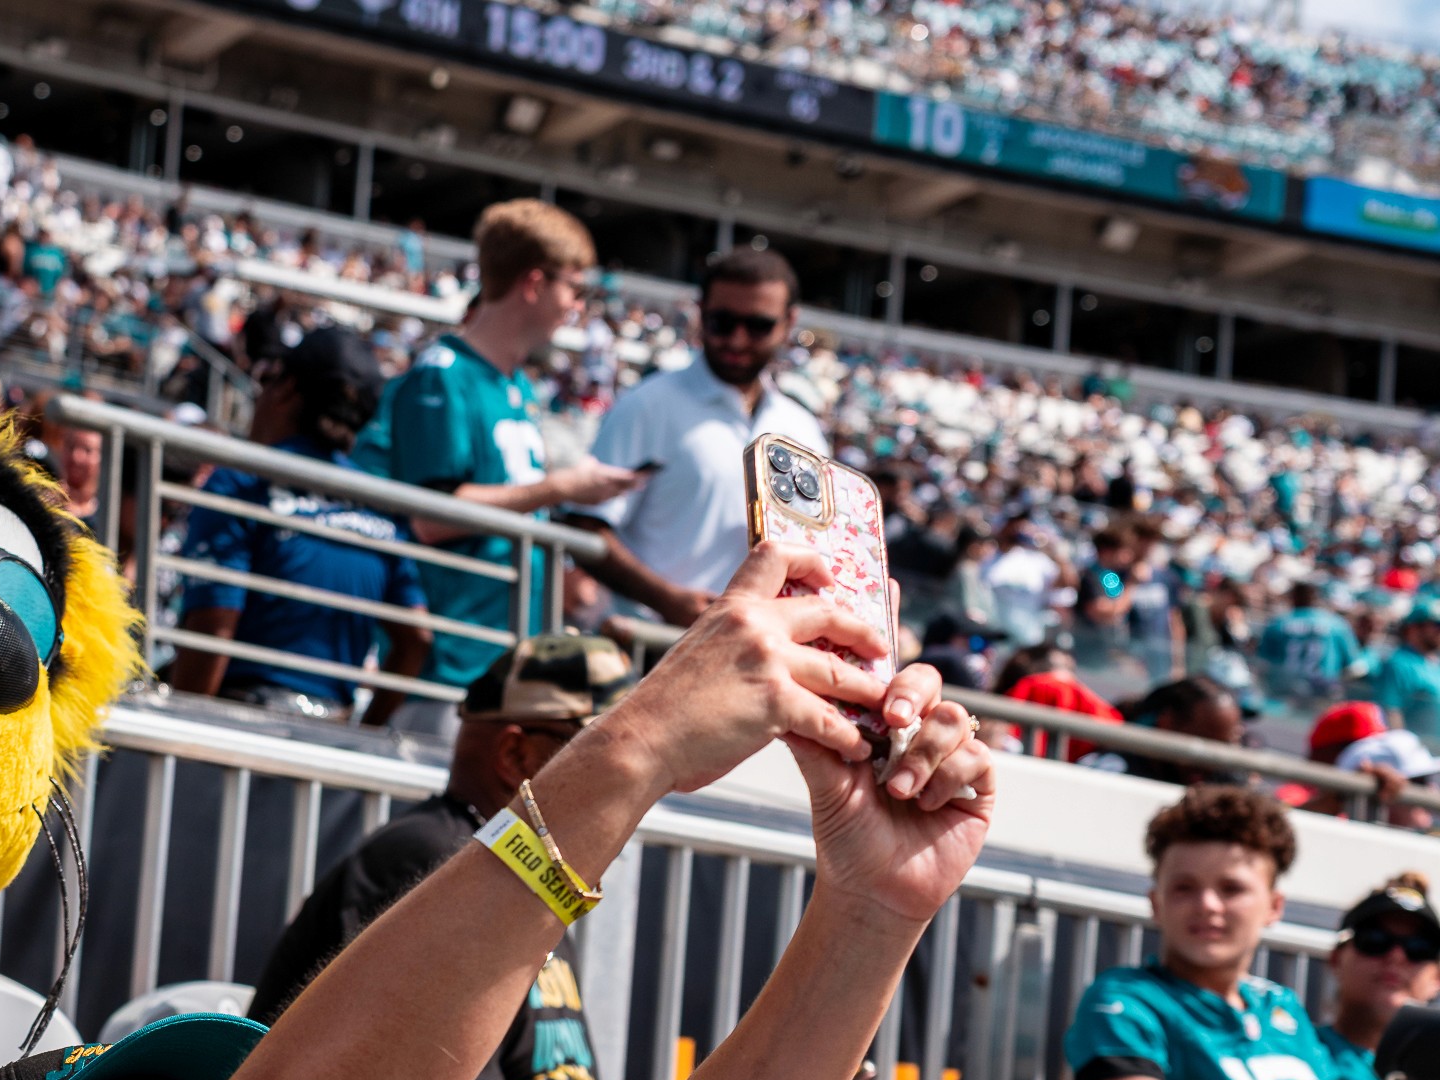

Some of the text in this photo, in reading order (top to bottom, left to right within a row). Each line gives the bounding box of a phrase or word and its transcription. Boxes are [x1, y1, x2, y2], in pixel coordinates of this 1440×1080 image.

[484, 4, 607, 74] 15:00
[717, 59, 746, 102] 2
[908, 96, 967, 157] 10
[504, 833, 544, 873] FIELD
[538, 866, 579, 910] SEATS
